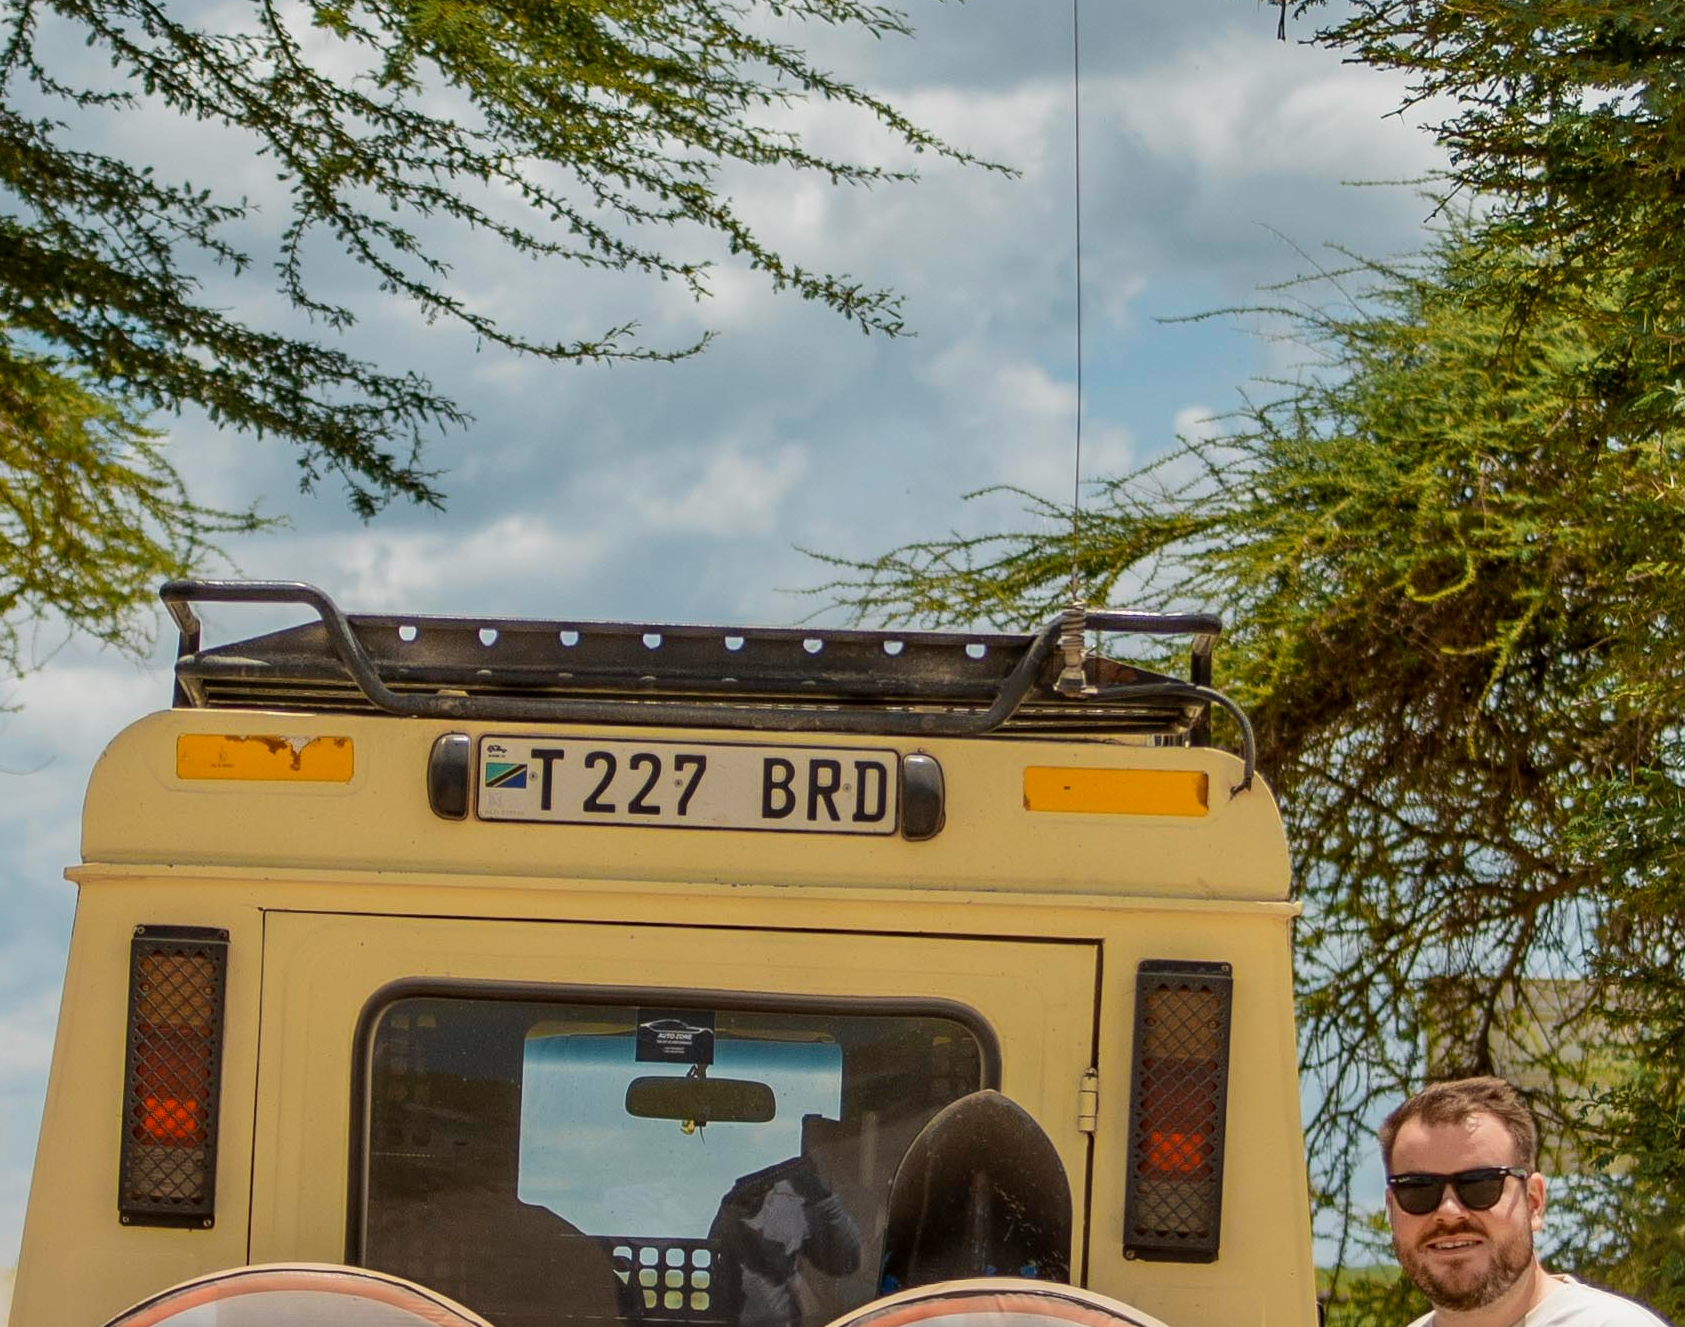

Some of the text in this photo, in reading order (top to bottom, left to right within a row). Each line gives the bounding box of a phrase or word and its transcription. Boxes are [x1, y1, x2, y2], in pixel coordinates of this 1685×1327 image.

[530, 748, 888, 822] T 227 BRD
